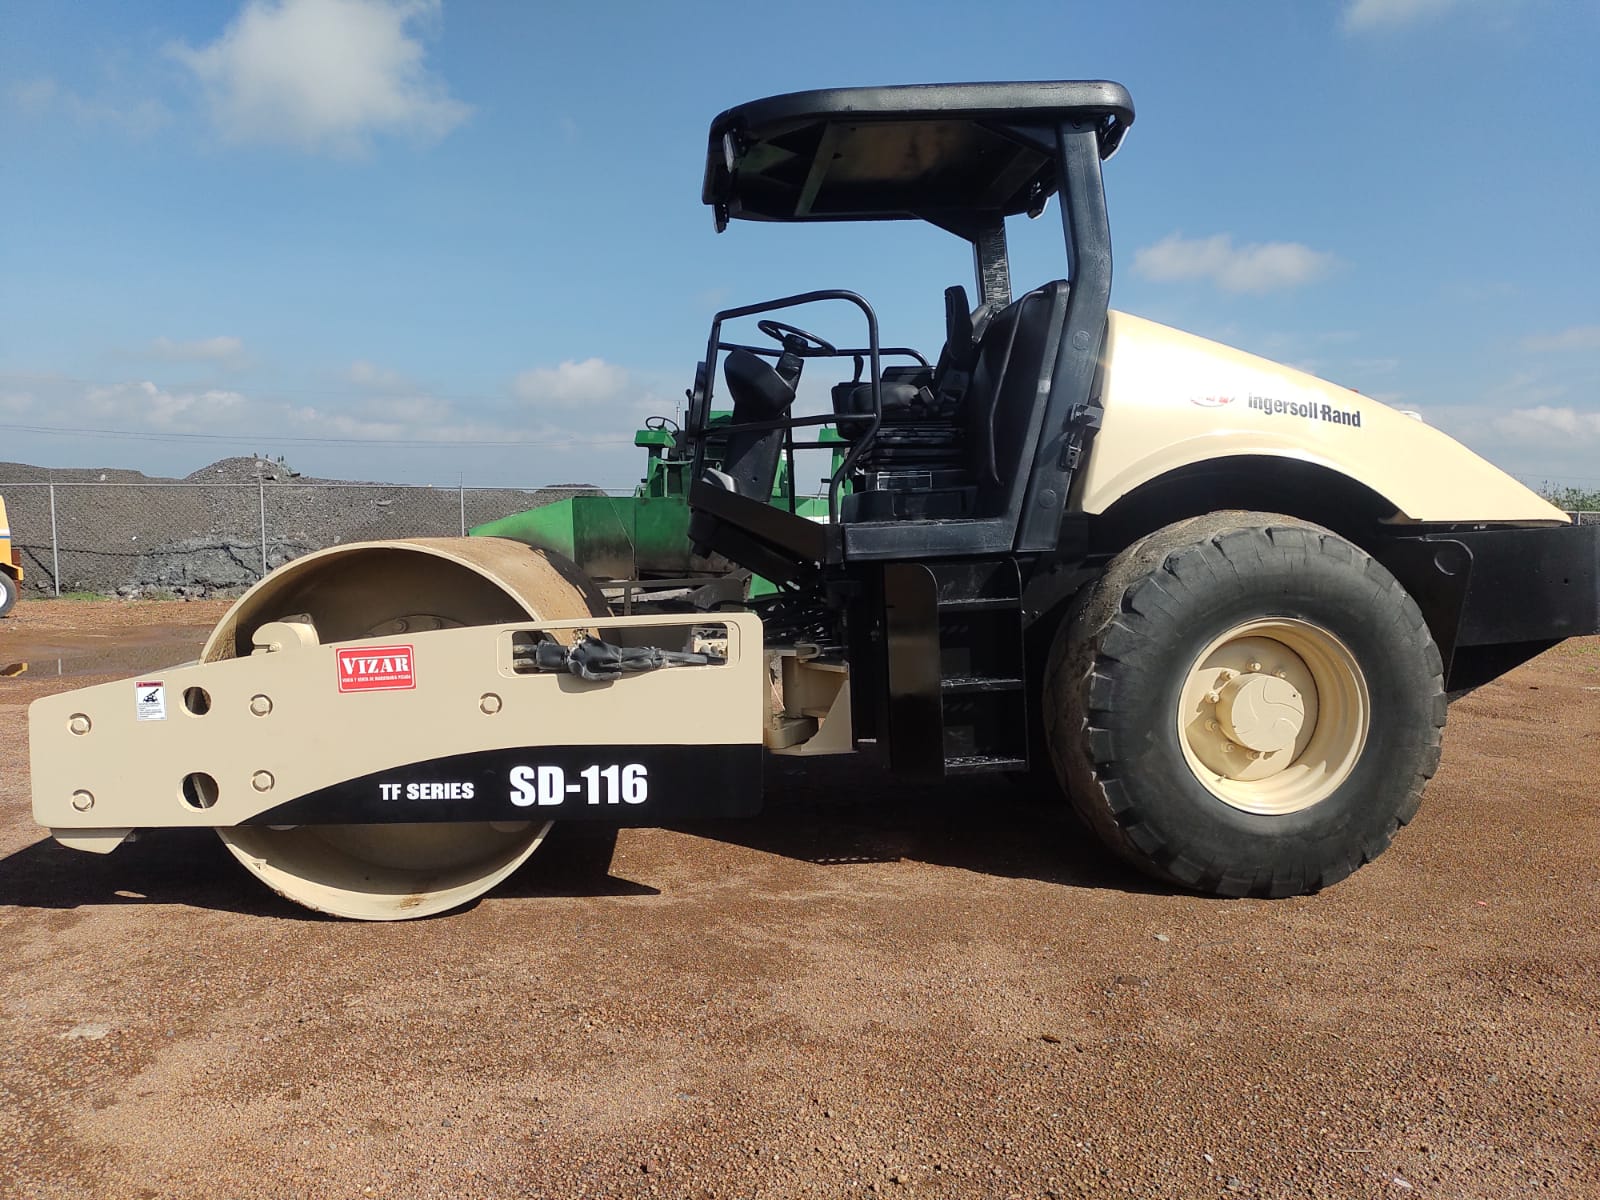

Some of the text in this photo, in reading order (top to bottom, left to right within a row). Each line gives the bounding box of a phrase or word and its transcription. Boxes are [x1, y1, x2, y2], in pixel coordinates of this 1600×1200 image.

[342, 655, 410, 675] VIZAR
[379, 782, 475, 800] TF SERIES
[509, 763, 648, 807] SD-116
